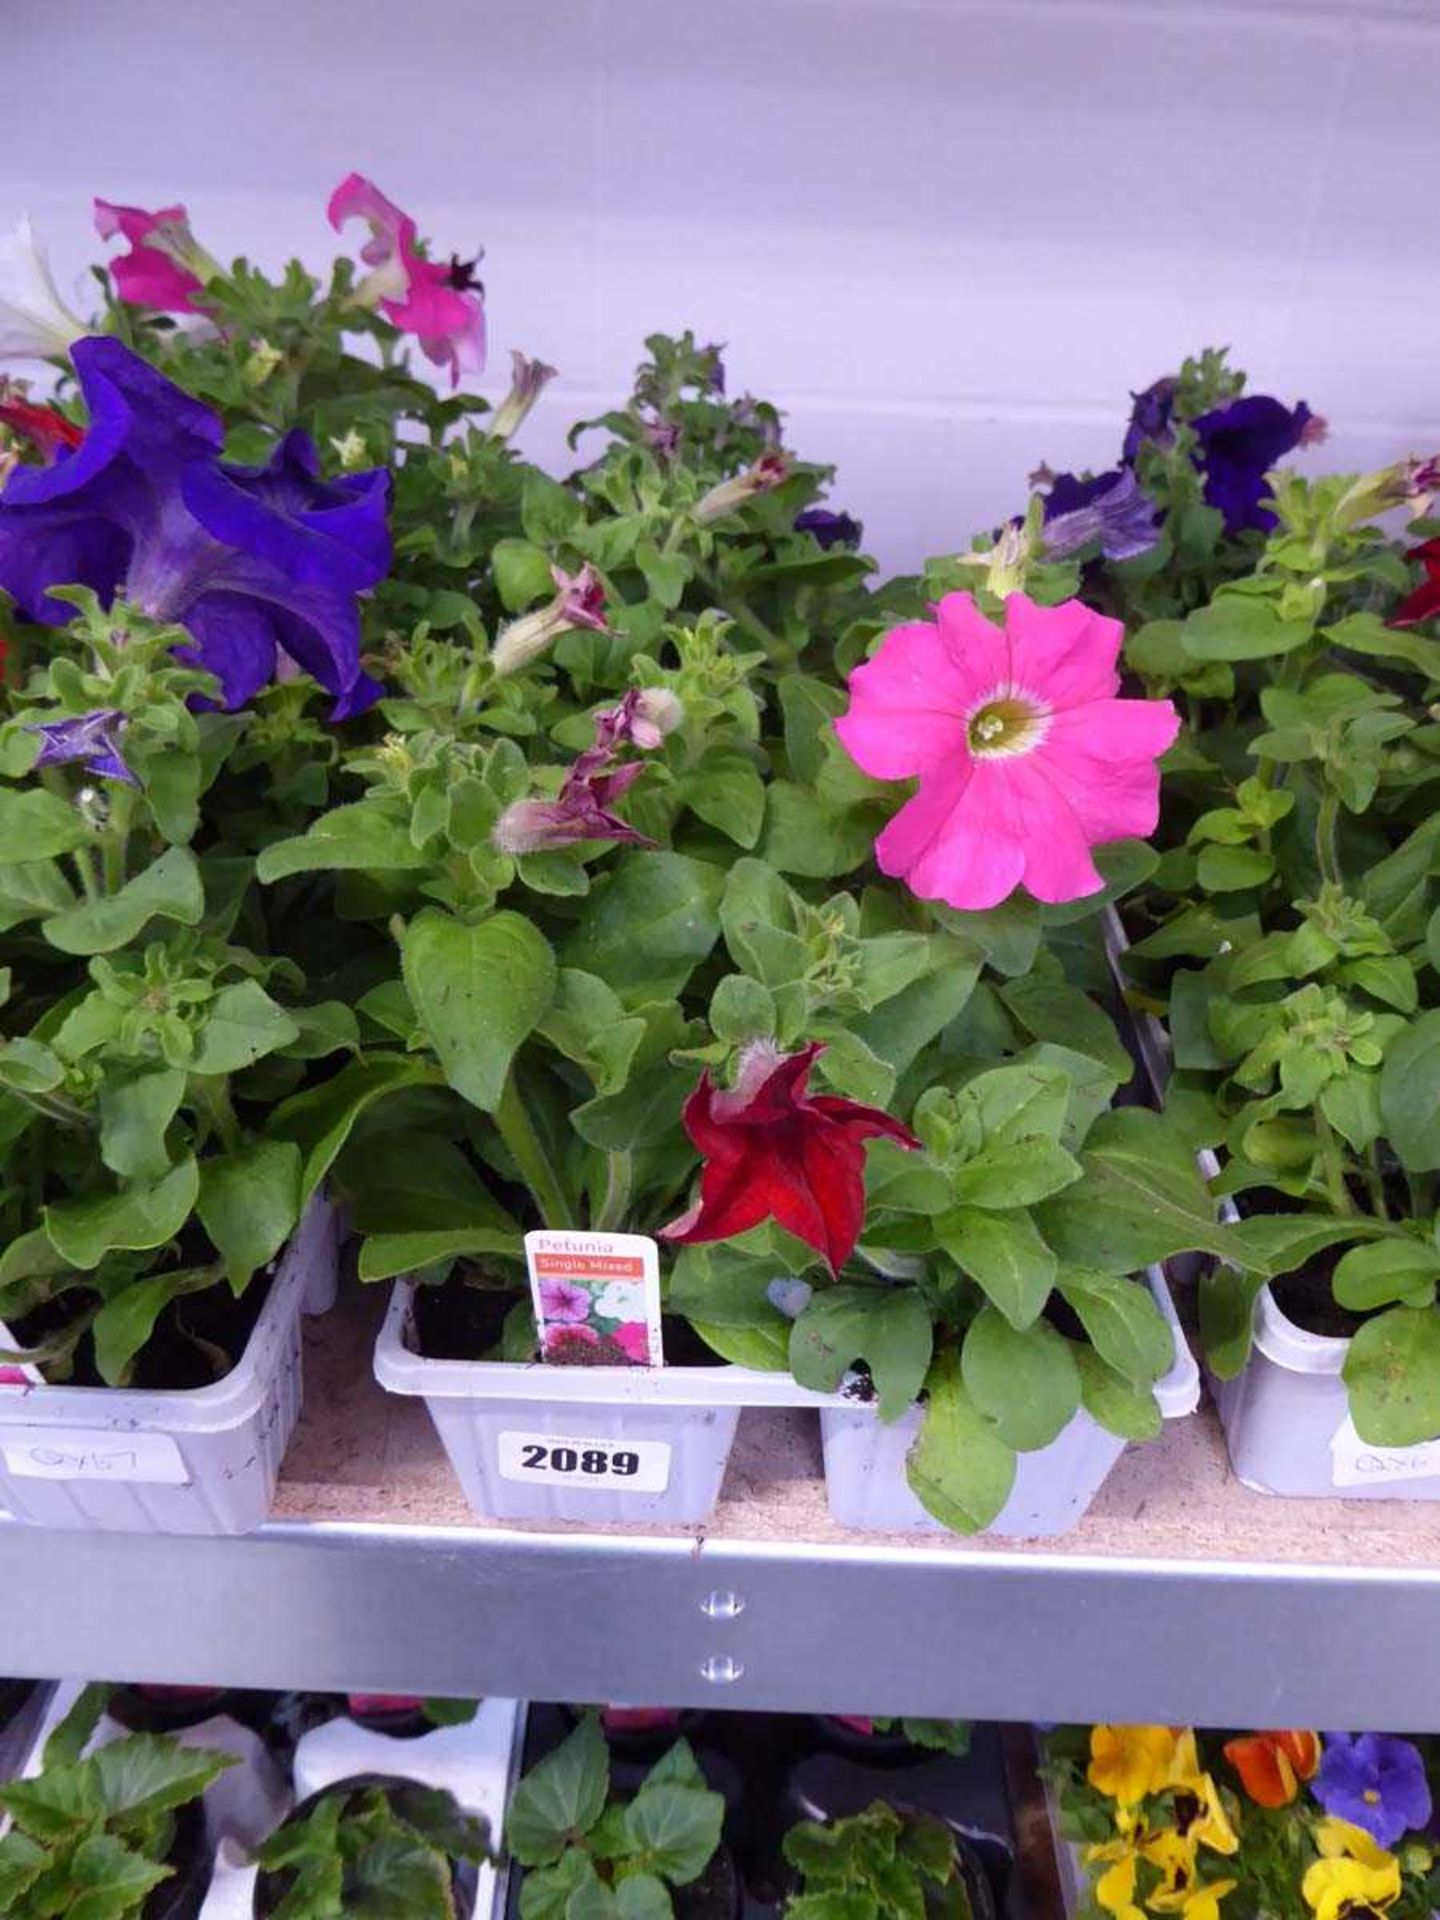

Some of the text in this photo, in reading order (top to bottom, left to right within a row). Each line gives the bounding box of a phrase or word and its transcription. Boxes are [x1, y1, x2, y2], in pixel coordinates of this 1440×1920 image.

[538, 1238, 614, 1254] Petunia
[539, 1257, 634, 1272] Single Mixed
[521, 1445, 640, 1476] 2089
